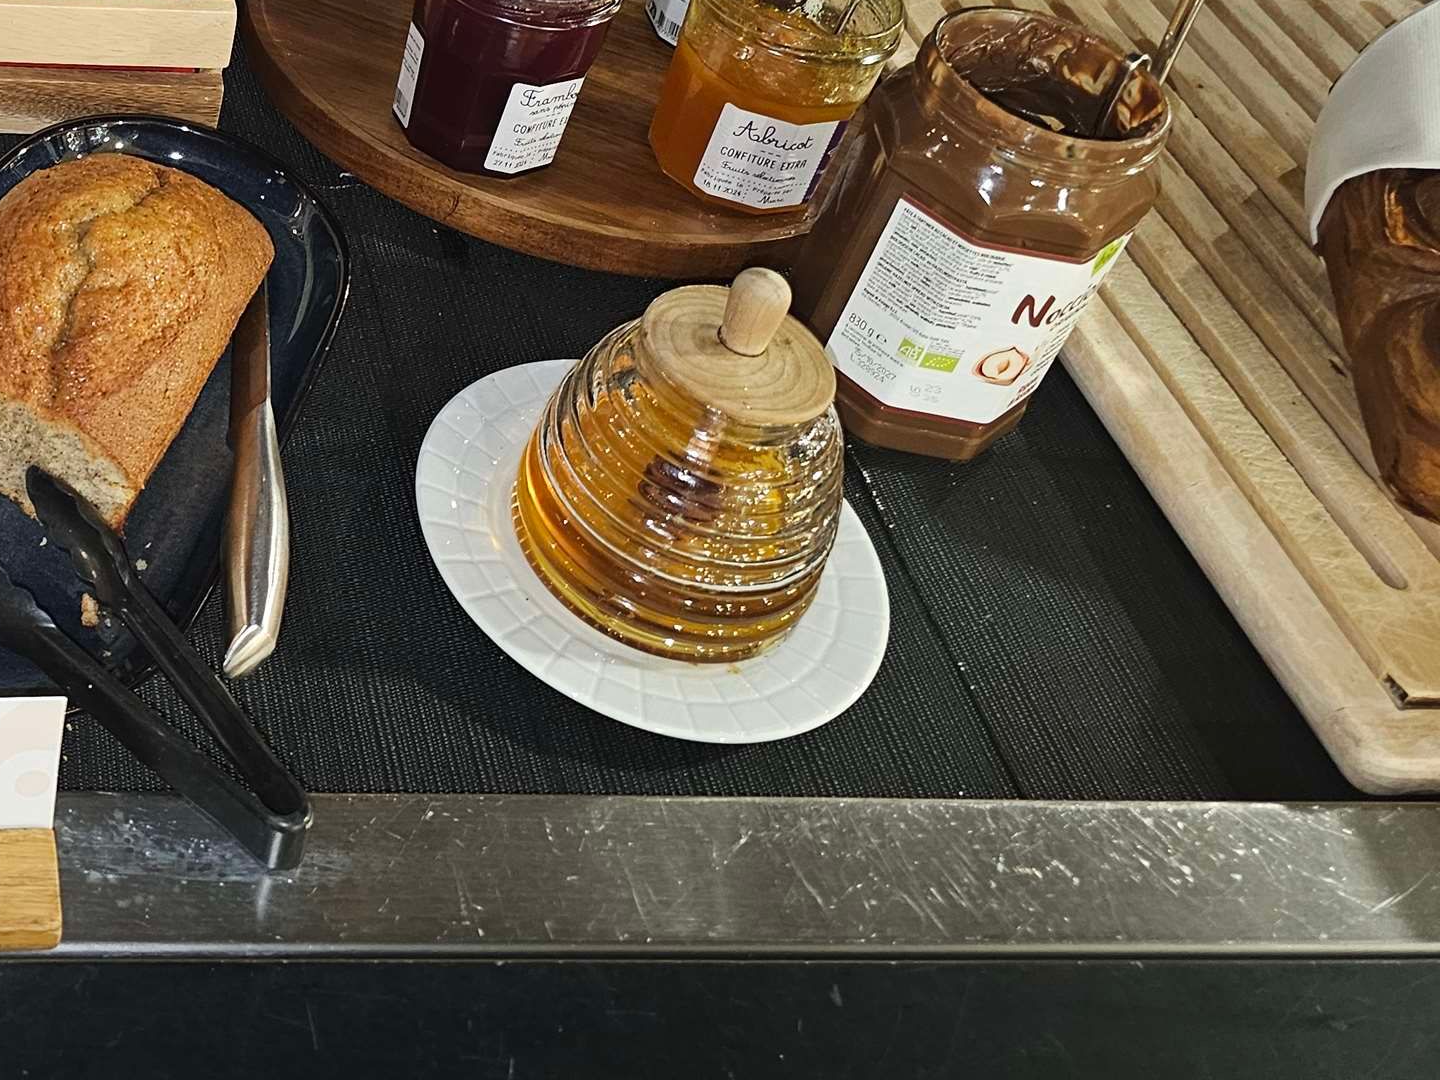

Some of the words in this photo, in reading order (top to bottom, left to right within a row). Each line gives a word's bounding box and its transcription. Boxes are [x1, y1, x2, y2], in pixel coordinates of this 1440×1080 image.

[732, 120, 815, 151] Abricot
[720, 146, 777, 171] CONFITURE
[779, 159, 808, 172] EXTRA
[848, 312, 868, 331] 830
